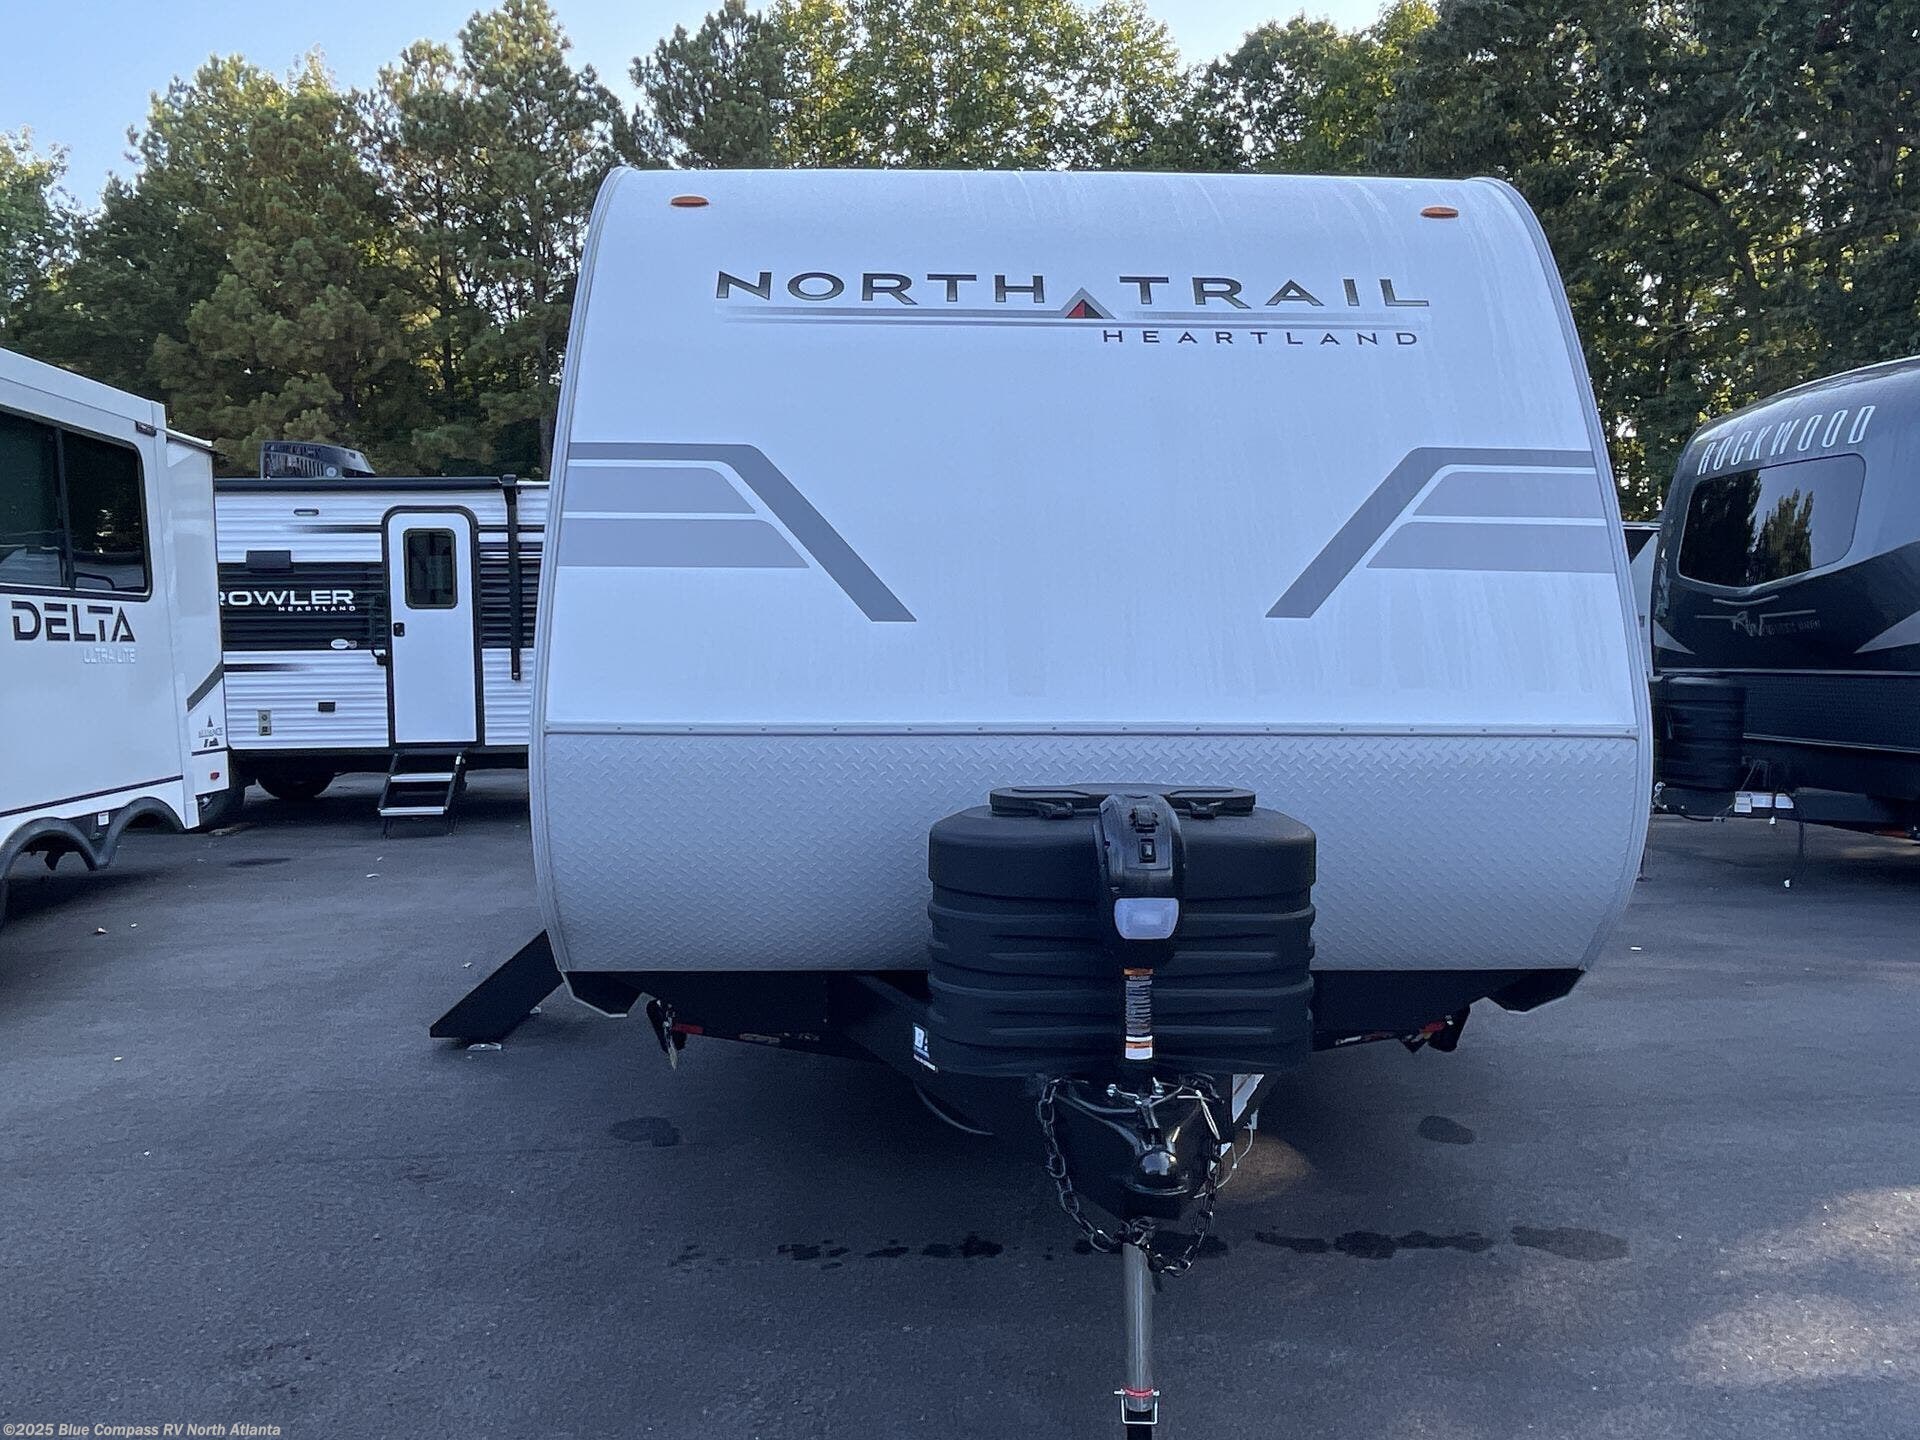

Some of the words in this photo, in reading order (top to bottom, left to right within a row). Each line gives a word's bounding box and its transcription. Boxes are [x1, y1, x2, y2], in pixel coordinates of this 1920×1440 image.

[716, 271, 1045, 305] NORTH
[1119, 276, 1430, 309] TRAIL
[1103, 329, 1417, 345] HEARTLAND
[1697, 405, 1876, 476] ROCKWOOD
[11, 600, 136, 642] DELTA
